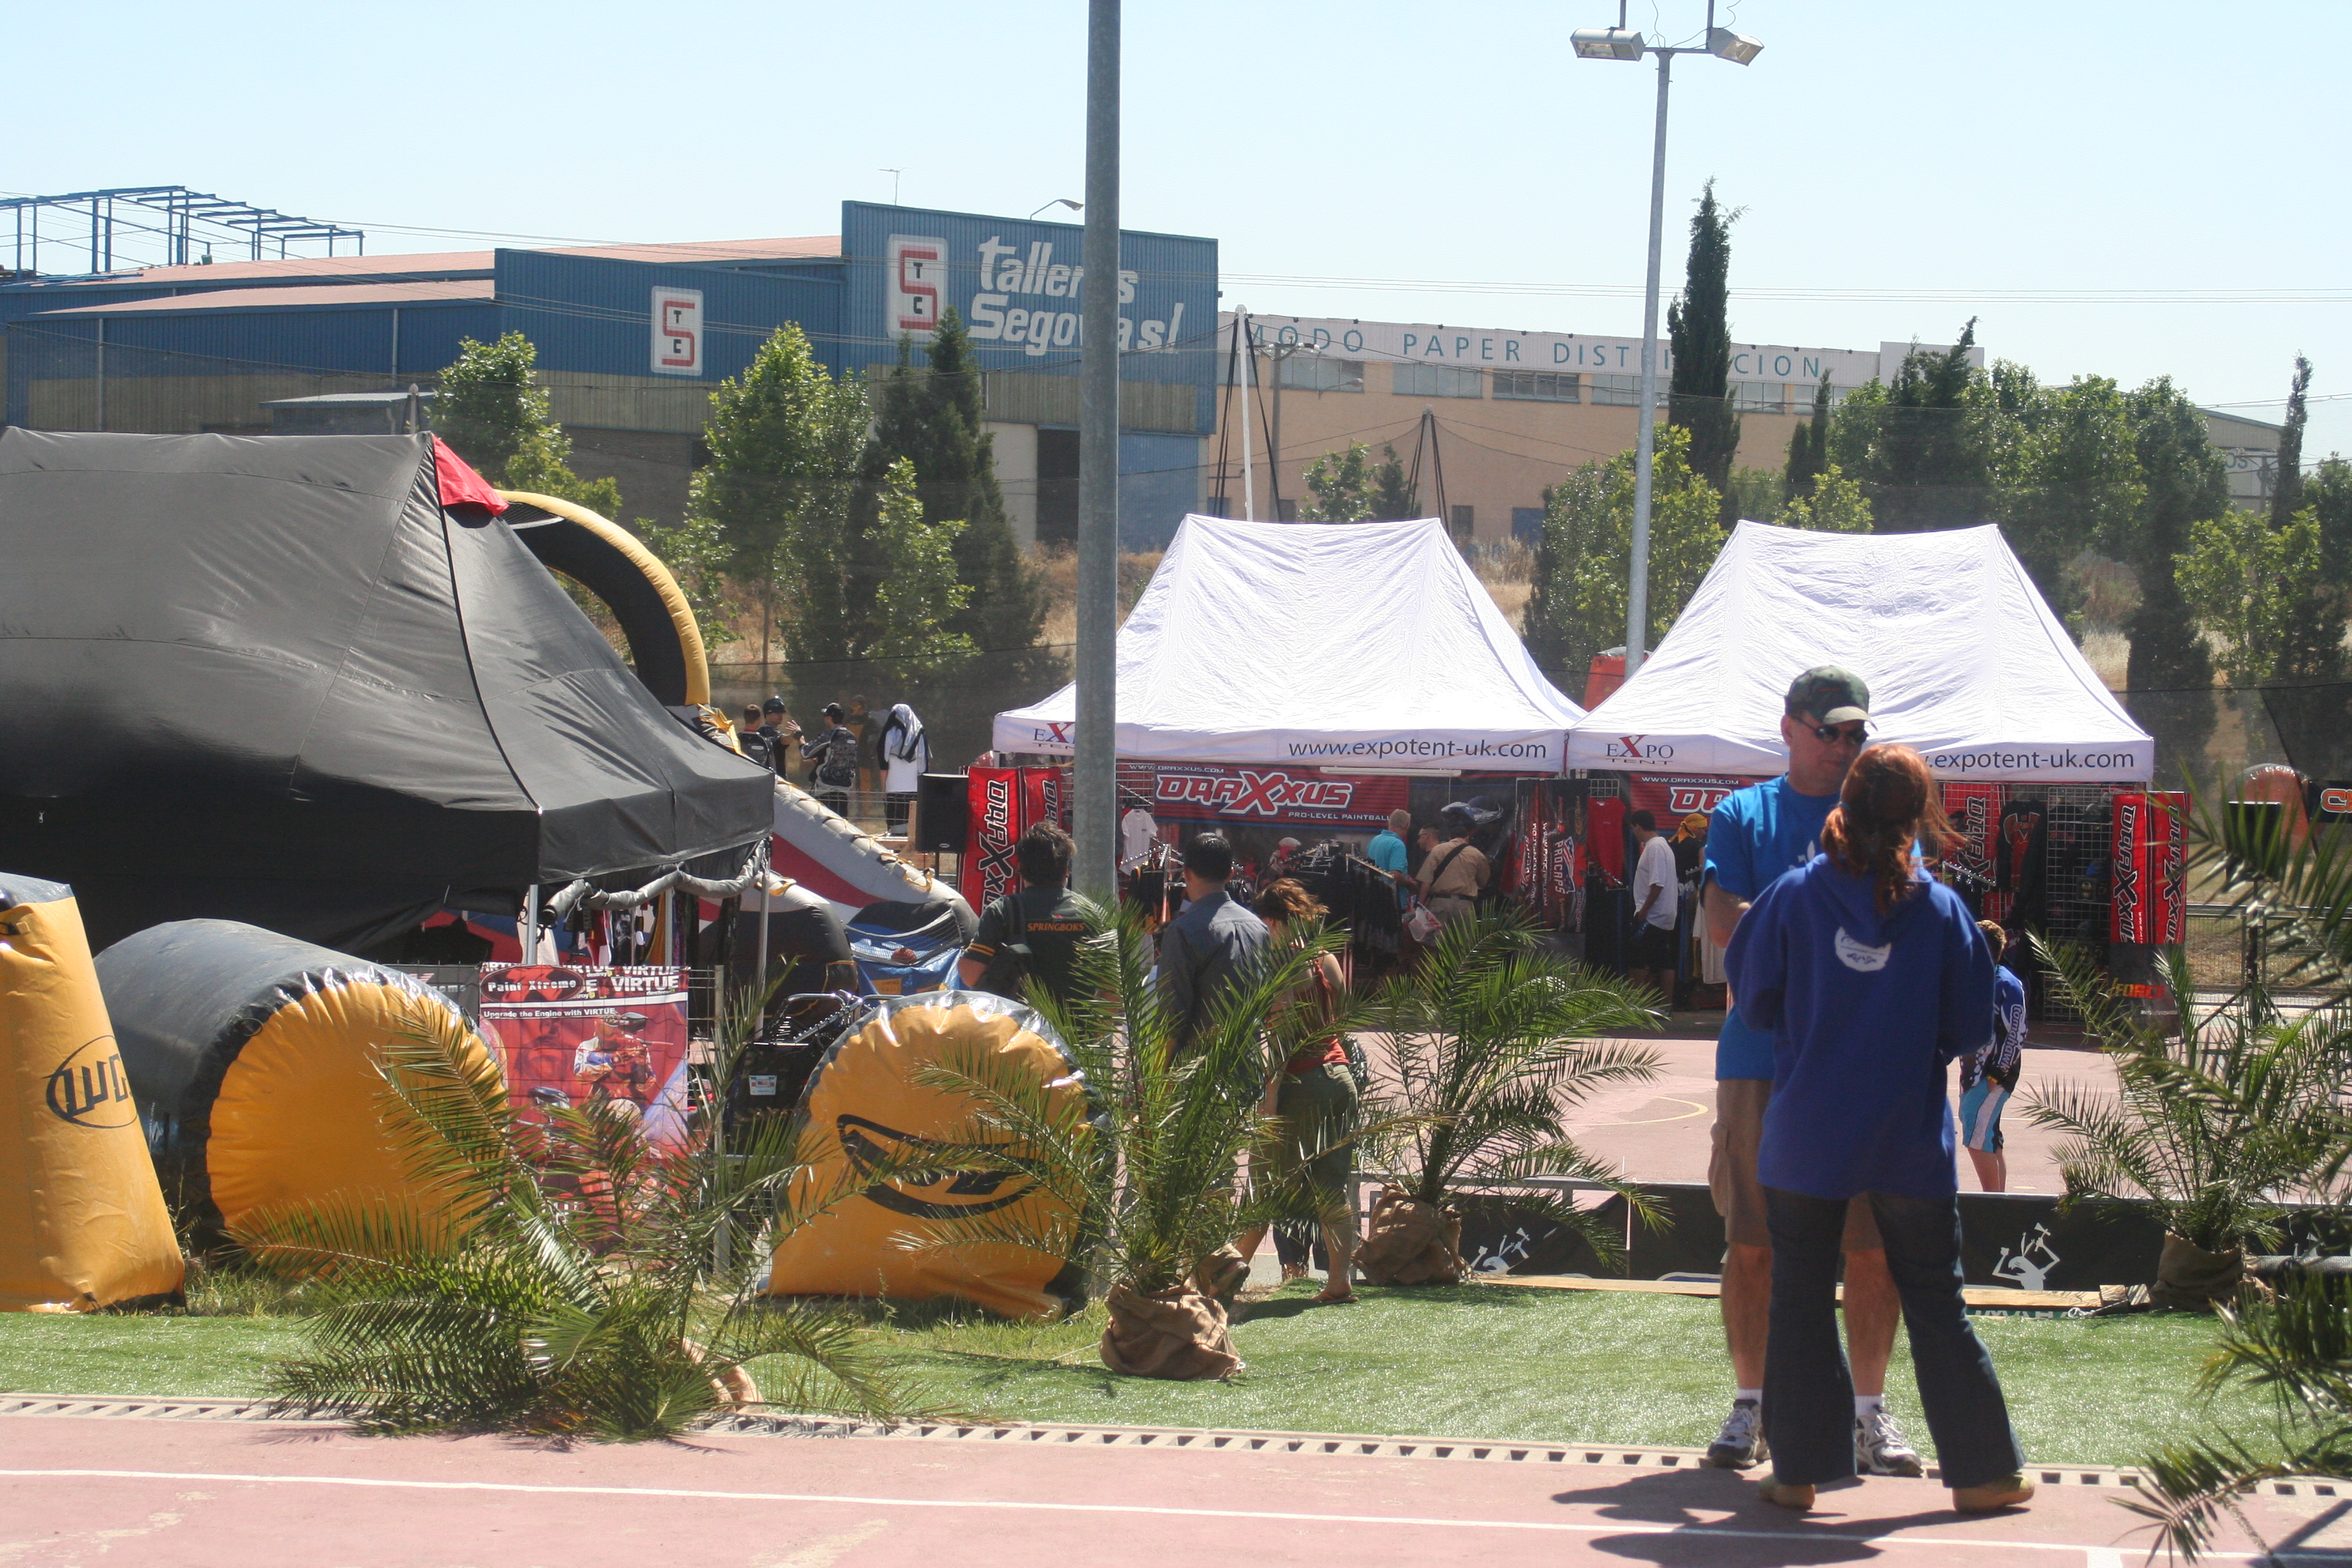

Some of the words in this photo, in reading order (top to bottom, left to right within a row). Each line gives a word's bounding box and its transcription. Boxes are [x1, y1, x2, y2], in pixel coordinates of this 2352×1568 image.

[978, 235, 1139, 304] tallers
[1403, 333, 1520, 362] PAPER
[1288, 738, 1547, 760] www.expotent-uk.com
[1606, 734, 1674, 760] EXPO
[1925, 749, 2134, 772] .expotent-uk.com
[1642, 777, 1739, 785] WWW.DRAXXUS.COM
[1288, 811, 1337, 820] PRO-LEVEL
[1027, 922, 1085, 932] SPRINGBOKS
[487, 981, 522, 992] Paint
[528, 979, 577, 991] Xtreme
[610, 976, 679, 993] VIRTUE
[483, 1010, 517, 1019] Upgrade
[535, 1010, 562, 1019] Engine
[584, 1007, 615, 1015] VIRTUE
[1999, 1005, 2023, 1072] tomahawk
